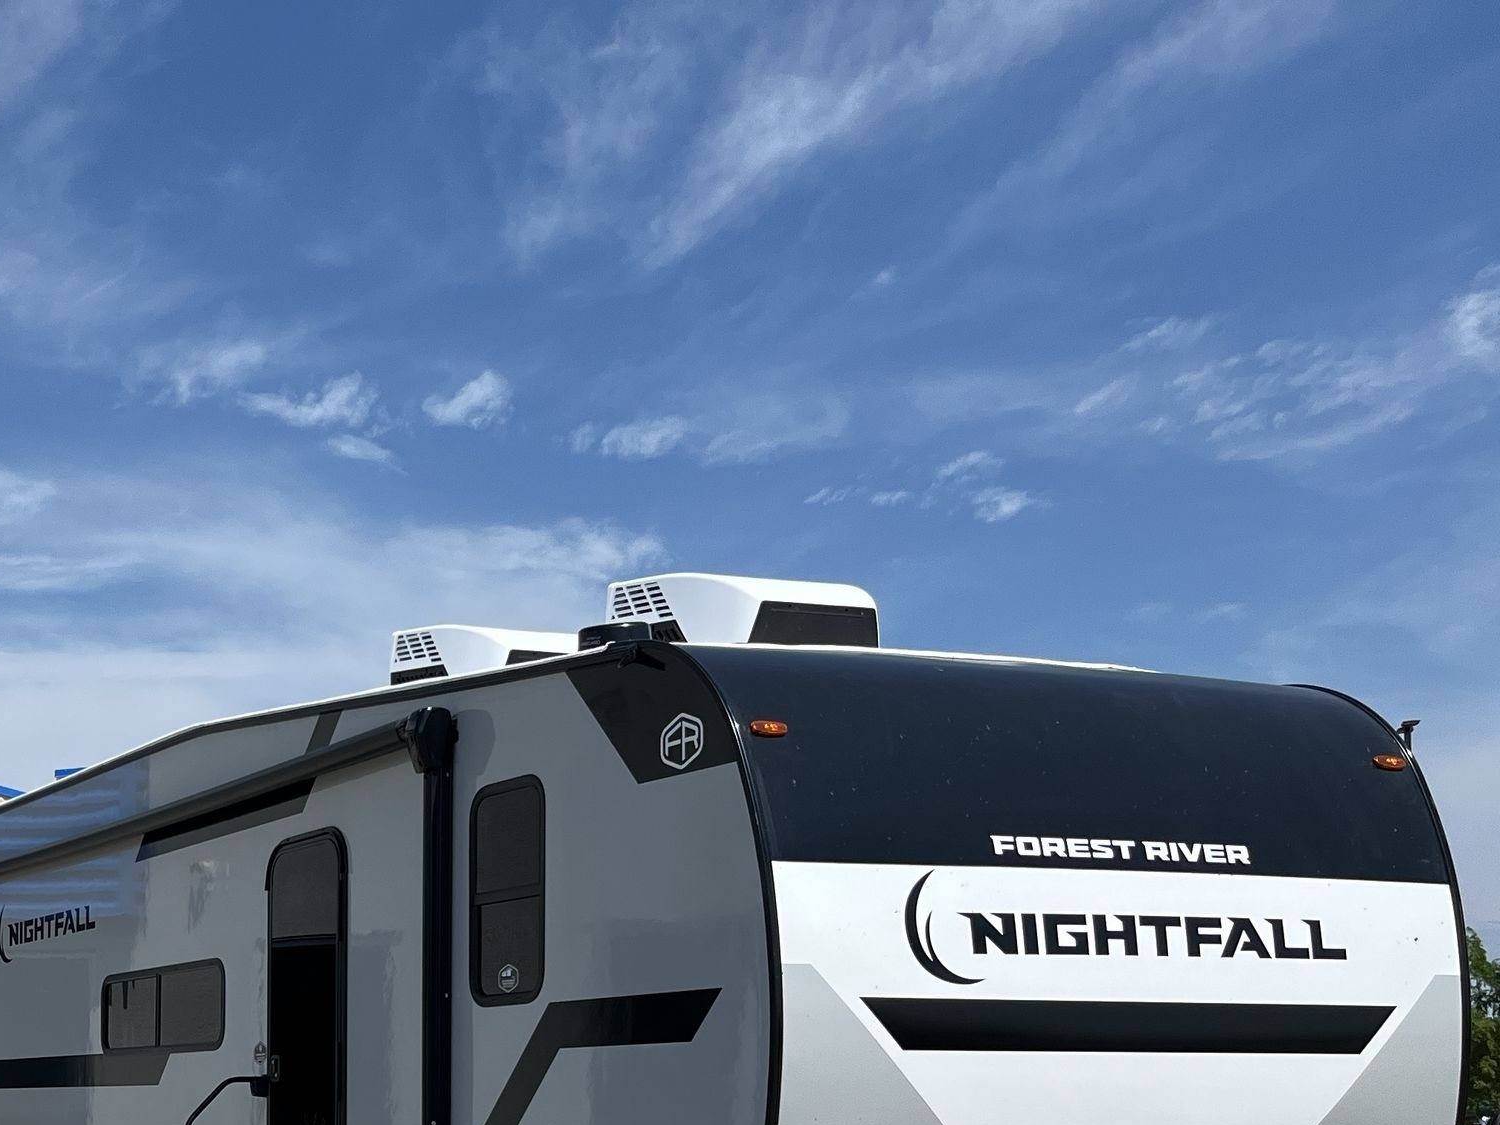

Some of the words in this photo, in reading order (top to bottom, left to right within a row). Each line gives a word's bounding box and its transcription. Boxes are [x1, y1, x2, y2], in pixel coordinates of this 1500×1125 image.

[989, 834, 1136, 860] FOREST
[1141, 840, 1252, 865] RIVER
[7, 904, 96, 947] NIGHTFALL
[956, 911, 1348, 961] NIGHTFALL
